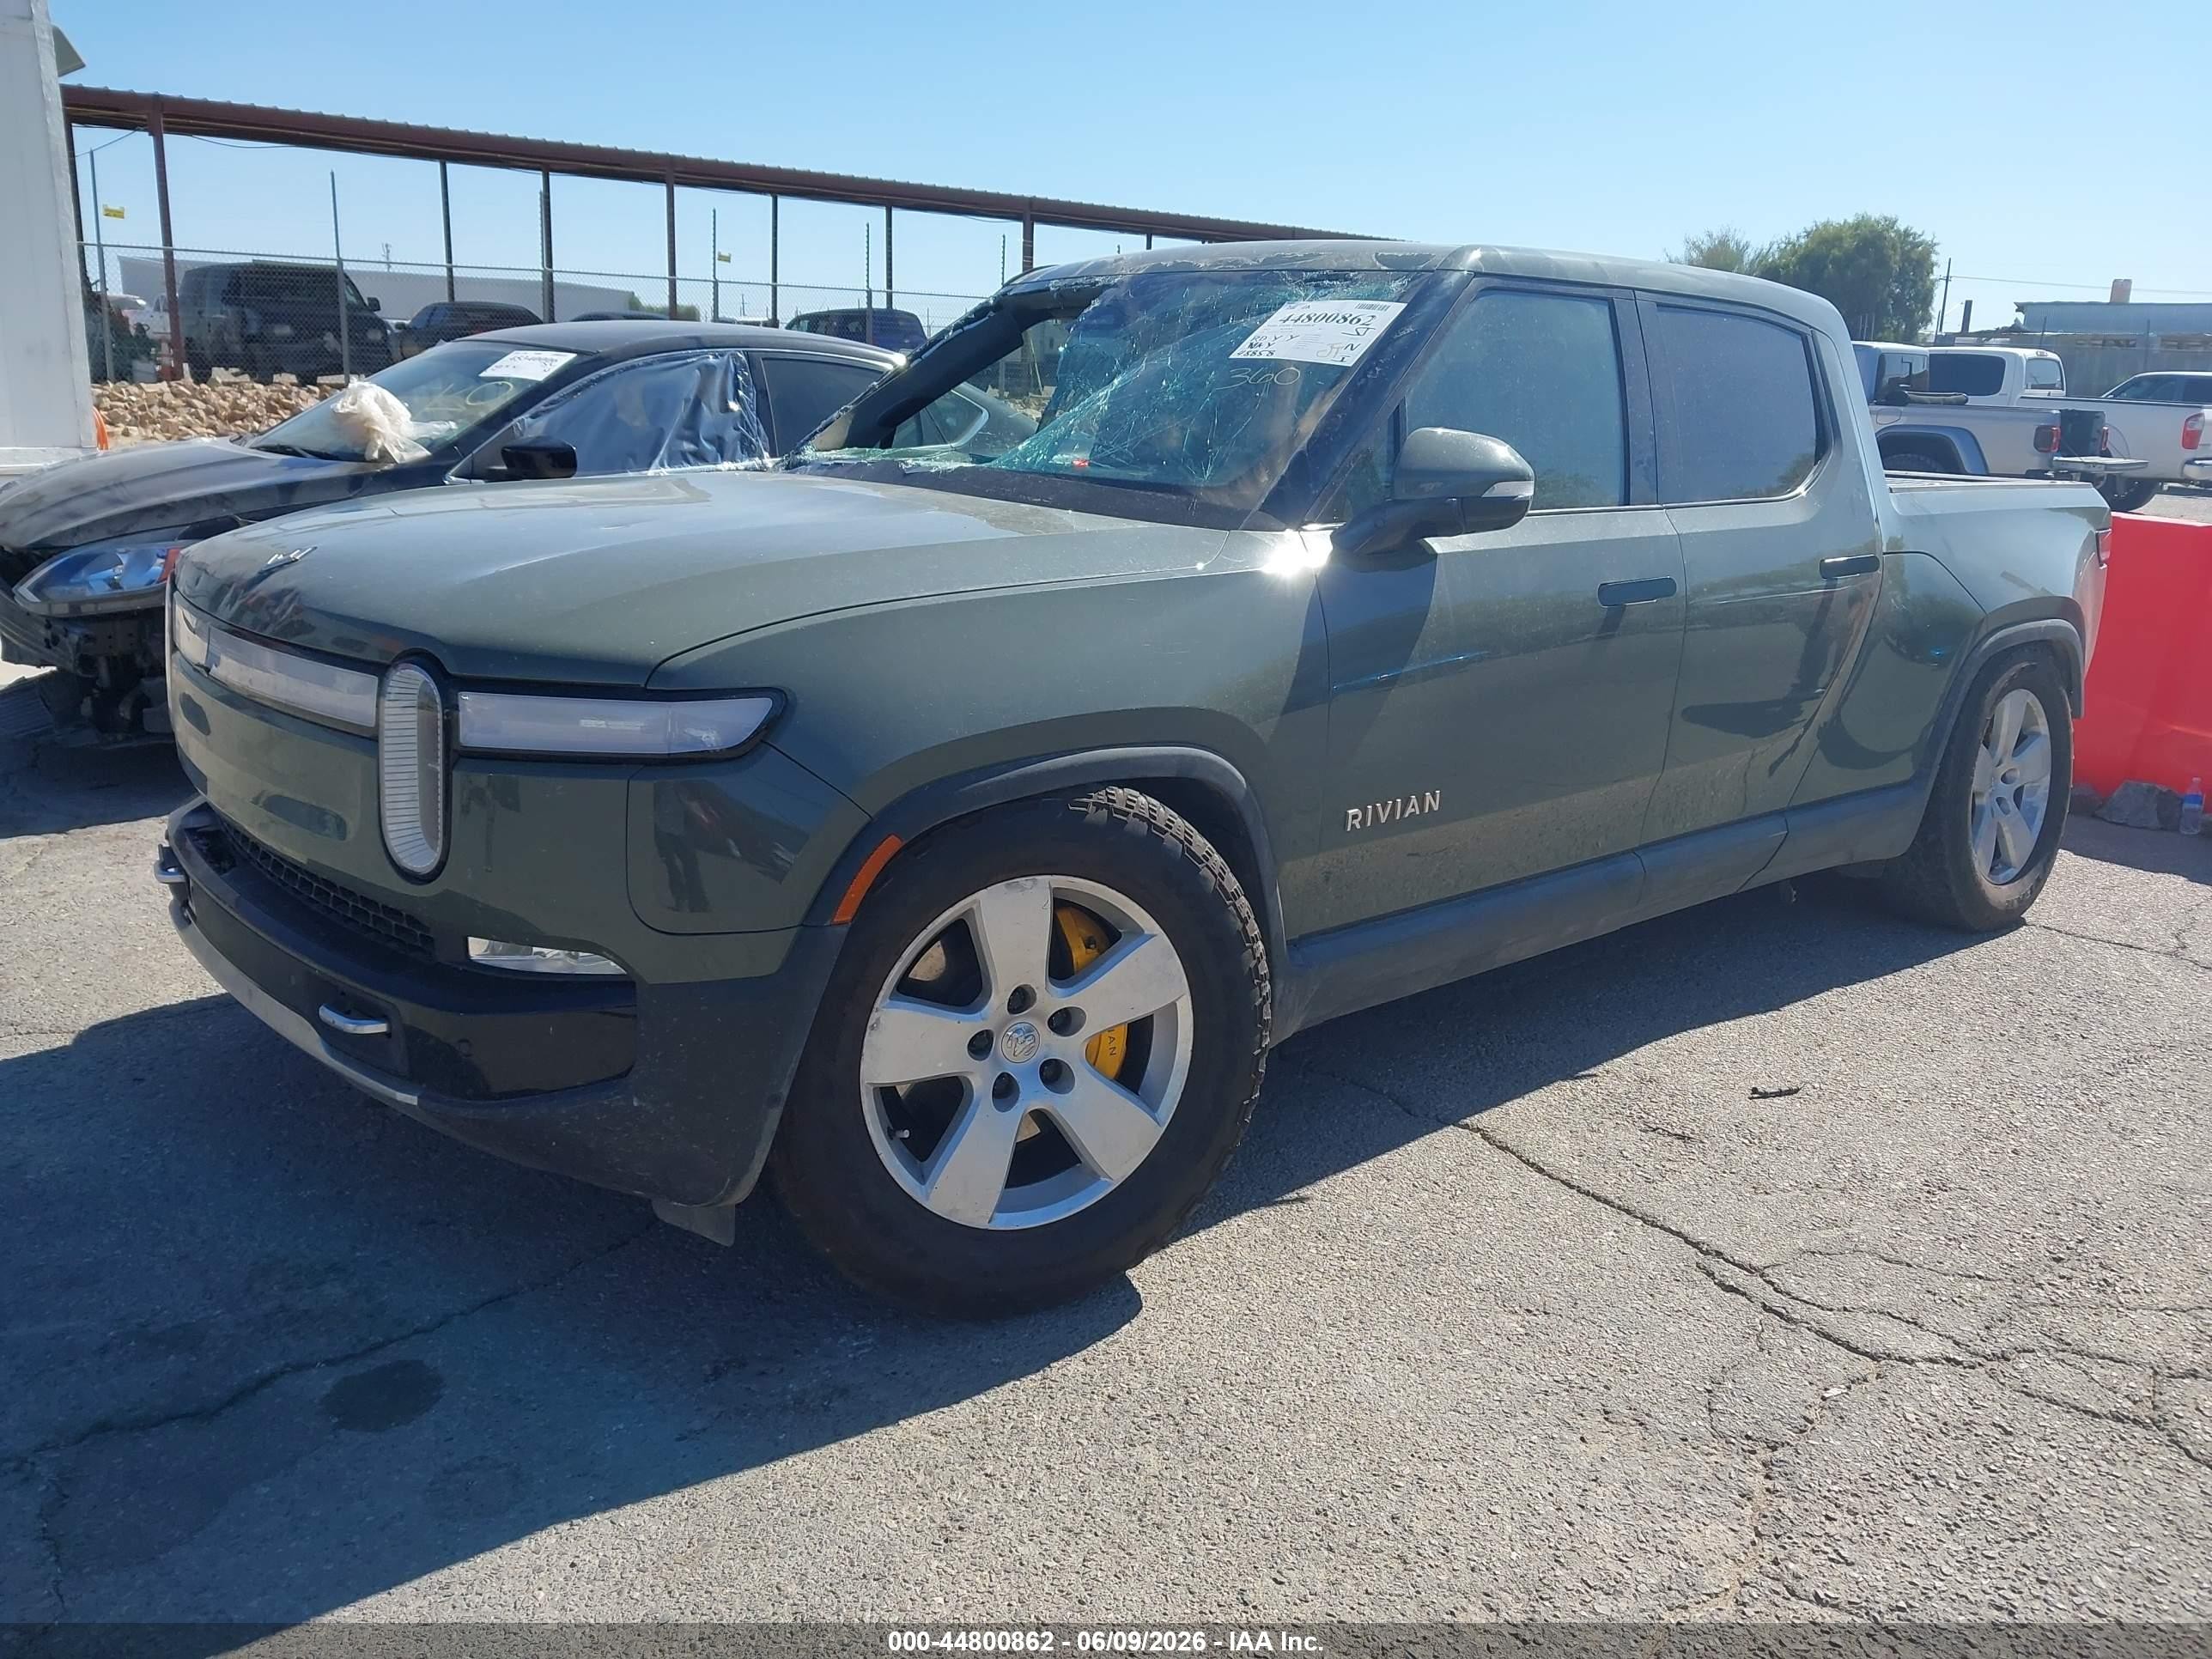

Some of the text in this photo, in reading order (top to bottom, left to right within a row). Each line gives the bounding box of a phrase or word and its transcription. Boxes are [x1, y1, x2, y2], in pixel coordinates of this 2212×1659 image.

[1279, 313, 1376, 325] 44800862
[1218, 367, 1301, 389] 360
[1346, 789, 1441, 832] RIVIAN
